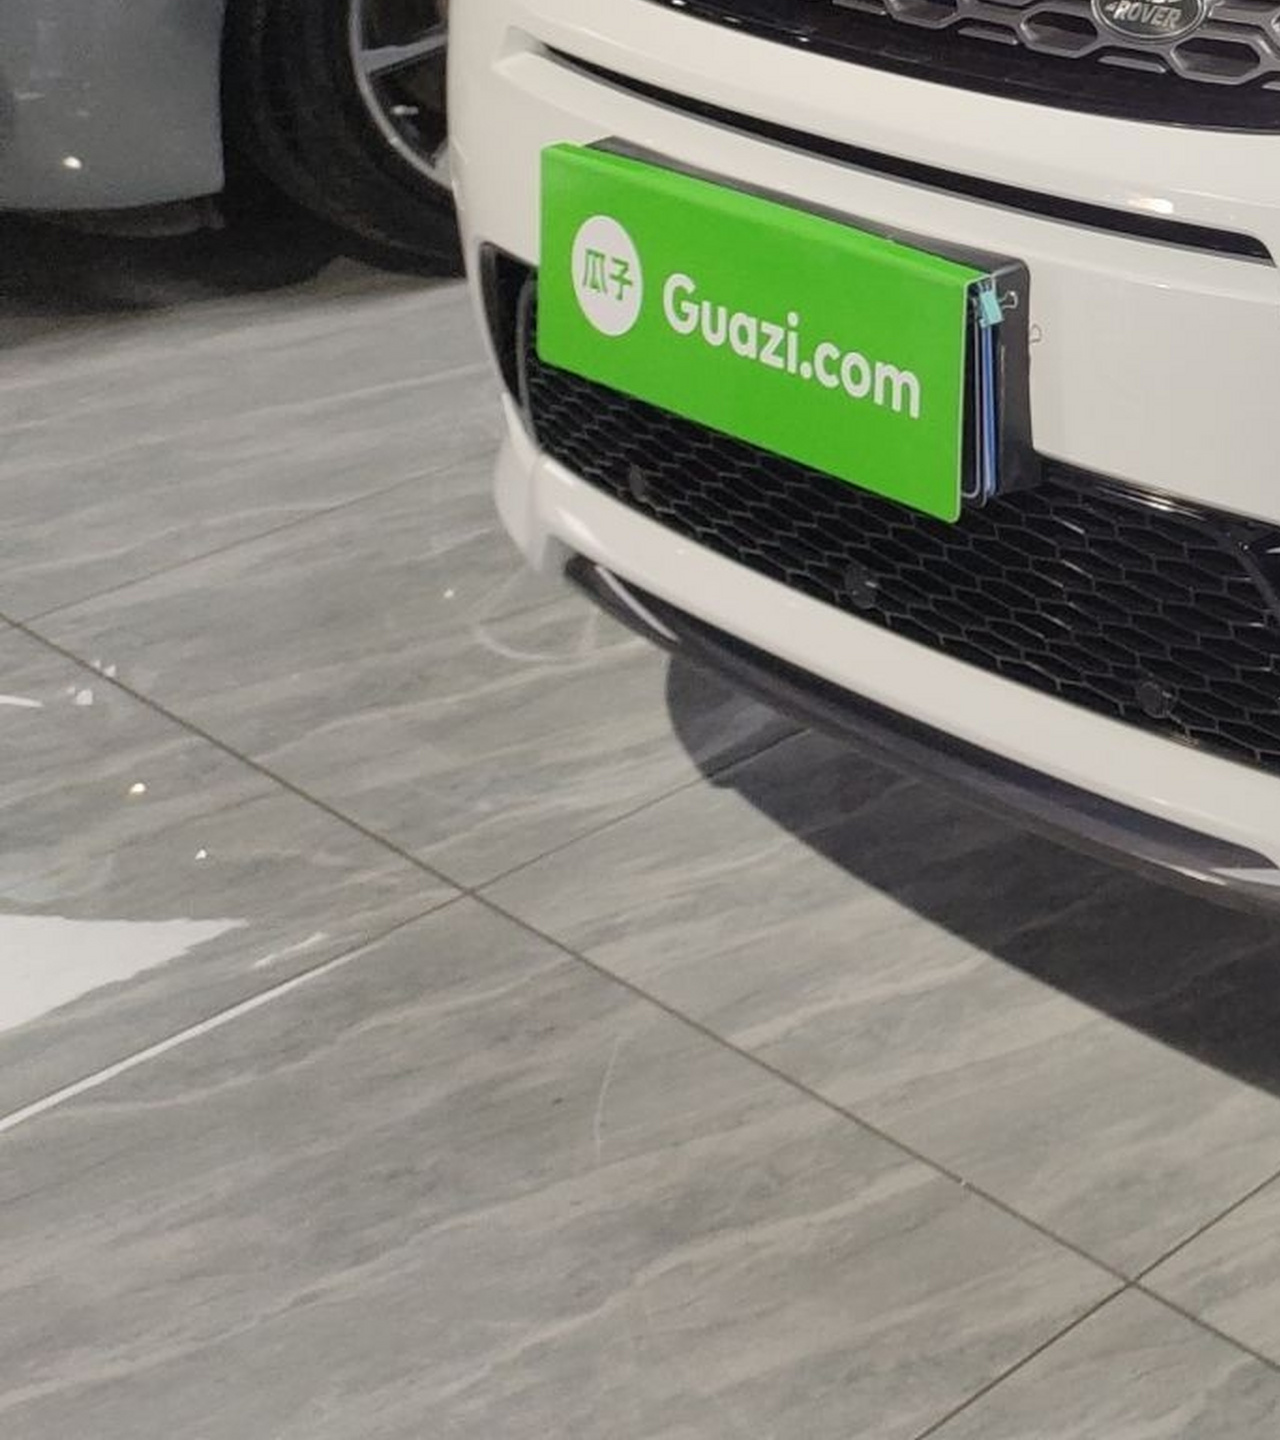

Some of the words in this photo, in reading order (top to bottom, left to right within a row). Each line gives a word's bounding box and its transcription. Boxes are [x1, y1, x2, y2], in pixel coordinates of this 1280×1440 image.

[1113, 0, 1182, 28] ROVER
[582, 247, 634, 302] 瓜子
[662, 272, 921, 420] Guazi.com
